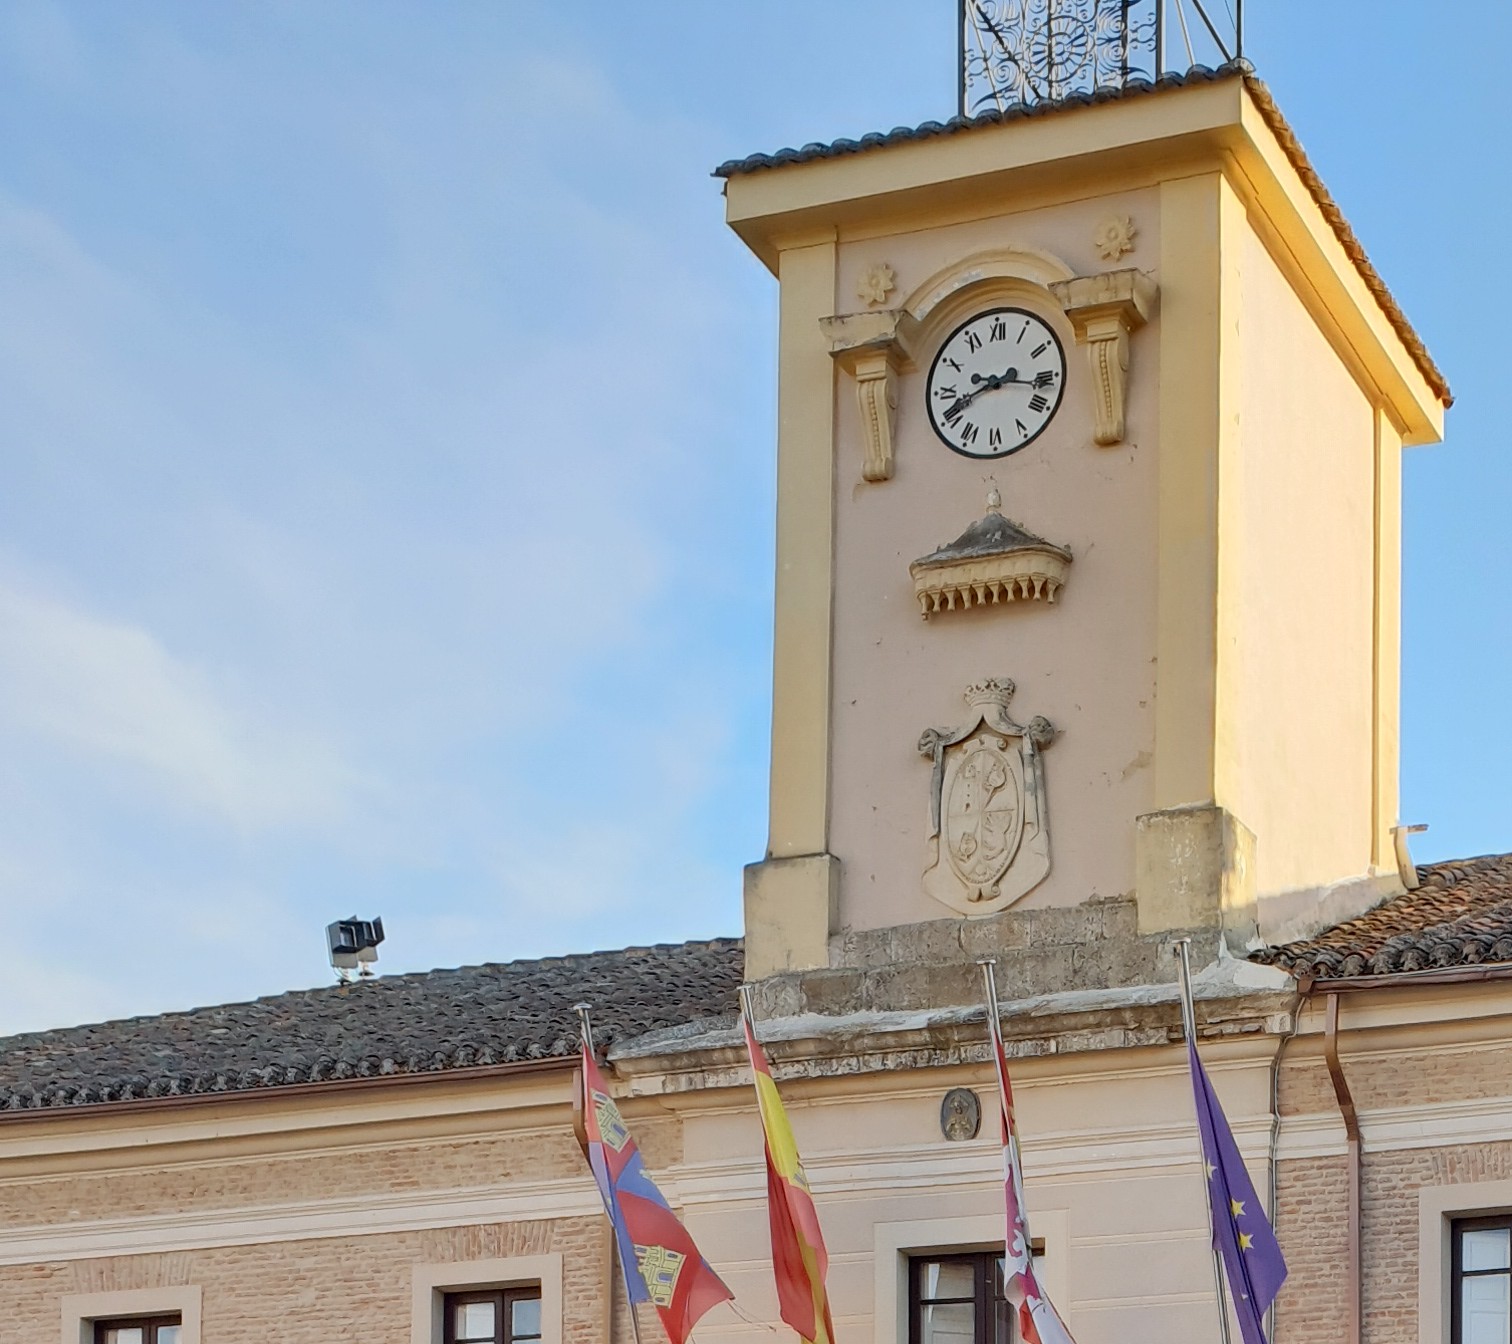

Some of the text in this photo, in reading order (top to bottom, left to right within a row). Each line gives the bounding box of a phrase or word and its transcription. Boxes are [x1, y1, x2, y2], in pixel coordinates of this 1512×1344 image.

[989, 322, 1006, 342] XII
[964, 332, 982, 354] XI
[1030, 343, 1047, 359] II
[946, 358, 965, 373] X
[940, 384, 957, 400] IX
[960, 422, 979, 444] VII
[1015, 418, 1027, 435] V
[989, 427, 1002, 446] VI
